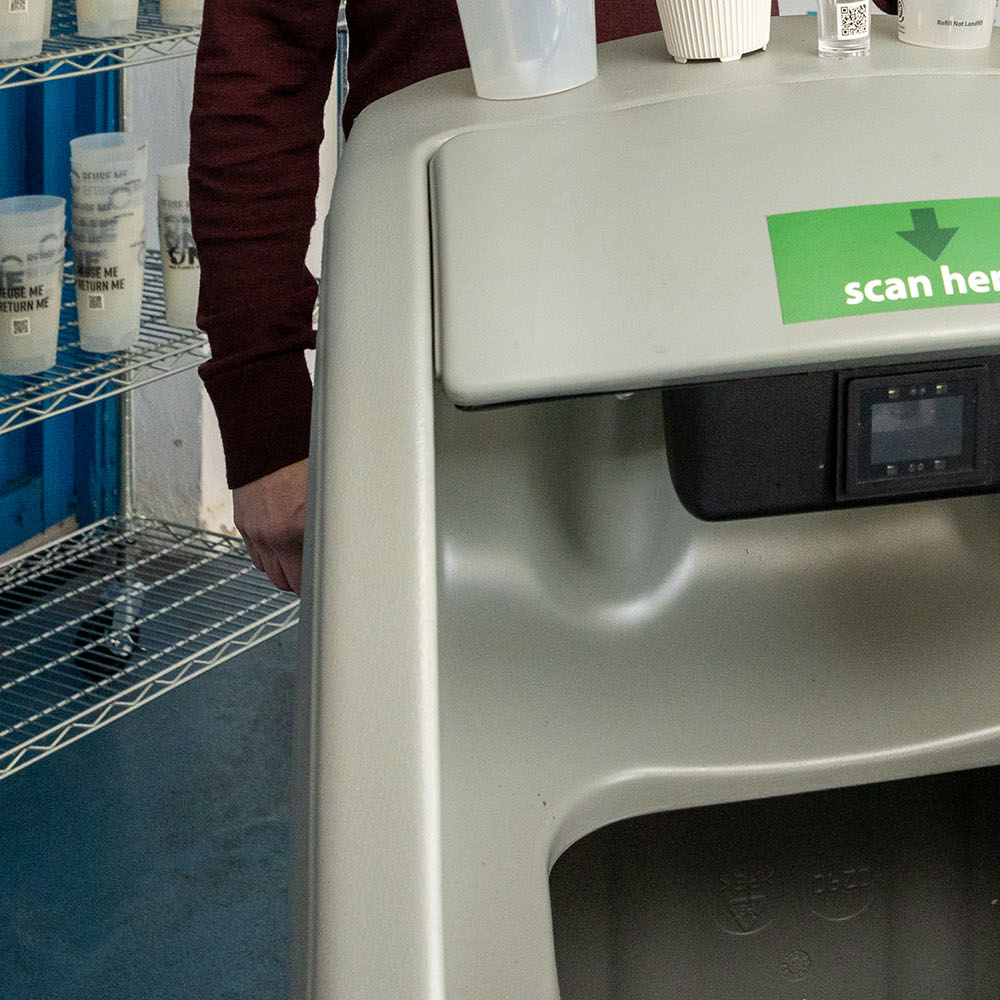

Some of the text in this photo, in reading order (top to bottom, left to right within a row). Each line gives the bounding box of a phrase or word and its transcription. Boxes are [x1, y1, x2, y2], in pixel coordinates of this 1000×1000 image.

[937, 19, 952, 27] Refill
[103, 266, 119, 278] ME
[110, 278, 126, 290] ME
[844, 275, 933, 305] scan
[29, 284, 44, 297] ME
[35, 296, 50, 309] ME
